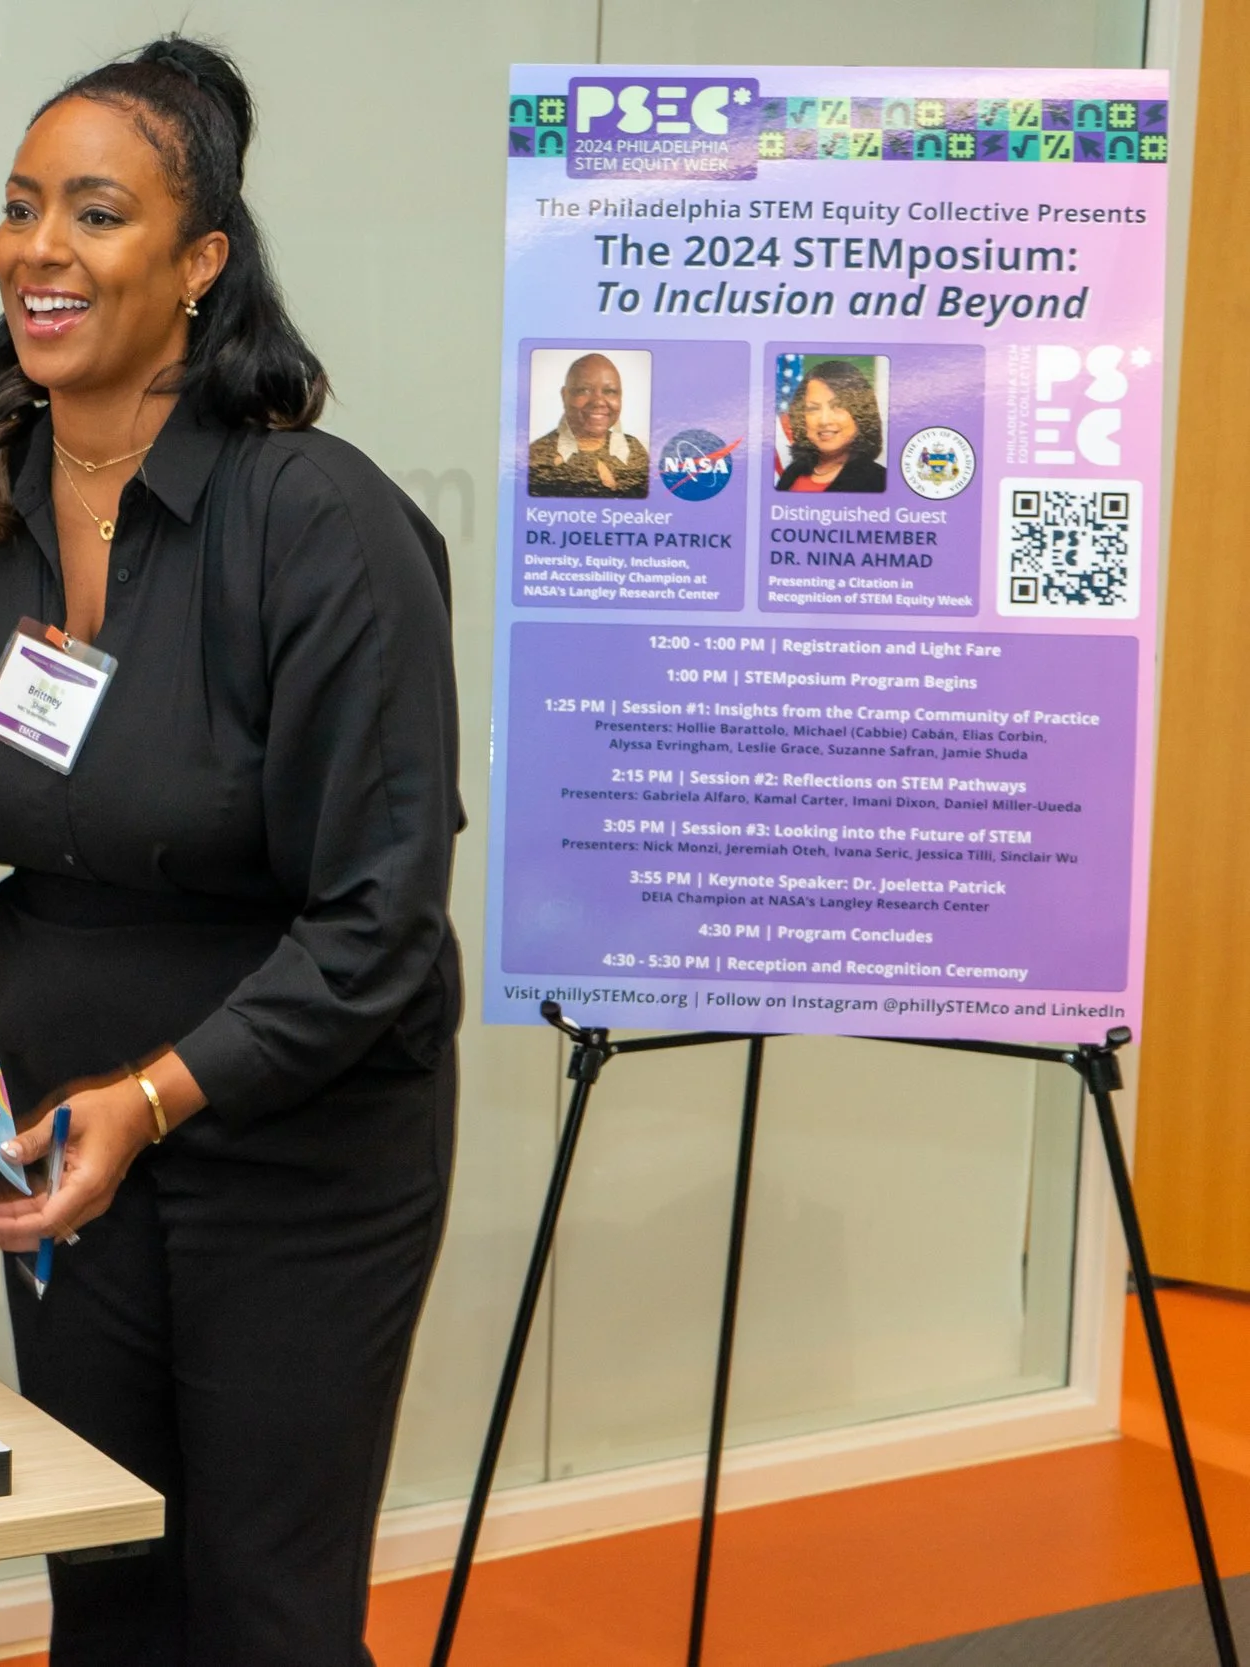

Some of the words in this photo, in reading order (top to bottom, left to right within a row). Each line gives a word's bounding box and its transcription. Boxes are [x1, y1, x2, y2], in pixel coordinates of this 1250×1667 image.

[574, 139, 612, 153] 2024
[617, 140, 728, 154] PHILADELPHIA
[575, 157, 617, 170] STEM
[621, 157, 680, 174] EQUITY
[683, 157, 728, 171] WEEK
[535, 198, 580, 216] The
[588, 198, 740, 222] Philadelphia
[749, 200, 812, 218] STEM
[822, 201, 900, 225] Equity
[908, 201, 1029, 221] Collective
[1038, 204, 1146, 223] Presents
[594, 233, 670, 266] The
[684, 236, 780, 267] 2024
[793, 237, 1076, 277] STEMposium:
[597, 281, 639, 312] To
[653, 282, 834, 314] Inclusion
[848, 284, 926, 316] and
[937, 286, 1089, 326] Beyond
[664, 456, 729, 474] NASA
[526, 507, 597, 526] Keynote
[601, 508, 673, 527] Speaker
[770, 505, 890, 525] Distinguished
[895, 507, 947, 524] Guest
[526, 530, 555, 544] DR.
[559, 531, 648, 548] JOELETTA
[654, 533, 731, 548] PATRICK
[770, 528, 937, 545] COUNCILMEMBER
[524, 554, 582, 568] Diversity,
[585, 555, 627, 569] Equity,
[630, 556, 689, 569] Inclusion,
[770, 550, 800, 565] DR.
[807, 551, 856, 566] NINA
[861, 553, 933, 568] AHMAD
[523, 570, 548, 580] and
[549, 570, 626, 584] Accessibility
[628, 572, 691, 585] Champion
[693, 574, 707, 584] at
[768, 575, 836, 590] Presenting
[837, 578, 846, 588] a
[848, 577, 898, 588] Citation
[901, 578, 913, 589] in
[523, 585, 566, 596] NASA's
[569, 586, 617, 600] Langley
[619, 587, 675, 598] Research
[677, 588, 720, 600] Center
[768, 591, 842, 605] Recognition
[844, 593, 858, 604] of
[860, 594, 892, 606] STEM
[895, 594, 935, 608] Equity
[937, 595, 973, 606] Week
[649, 635, 690, 649] 12:00
[704, 636, 736, 650] 1:00
[740, 637, 765, 651] PM
[782, 638, 881, 655] Registration
[885, 641, 916, 654] and
[920, 642, 961, 659] Light
[965, 643, 1001, 657] Fare
[667, 669, 699, 682] 1:00
[702, 669, 727, 682] PM
[744, 670, 846, 687] STEMposium
[850, 673, 919, 690] Program
[924, 675, 977, 692] Begins
[27, 684, 62, 710] Brittney
[545, 698, 576, 712] 1:25
[580, 699, 605, 712] PM
[622, 700, 682, 714] Session
[685, 702, 710, 715] #1:
[714, 703, 778, 720] Insights
[782, 704, 821, 718] from
[825, 705, 853, 719] the
[857, 706, 911, 723] Cramp
[914, 708, 1009, 726] Community
[1012, 710, 1030, 723] of
[1033, 710, 1100, 725] Practice
[18, 724, 41, 742] EMCEE
[595, 720, 672, 732] Presenters:
[676, 722, 716, 734] Hollie
[720, 723, 788, 736] Barattolo,
[793, 725, 847, 737] Michael
[850, 726, 907, 739] (Cabbie)
[911, 728, 957, 741] Cabán,
[962, 729, 994, 741] Elias
[997, 730, 1047, 743] Corbin,
[608, 738, 652, 752] Alyssa
[656, 739, 732, 754] Evringham,
[737, 742, 776, 753] Leslie
[780, 742, 823, 755] Grace,
[828, 744, 886, 756] Suzanne
[889, 745, 938, 758] Safran,
[941, 748, 982, 760] Jamie
[985, 748, 1028, 760] Shuda
[629, 870, 662, 884] 3:55
[666, 871, 691, 885] PM
[708, 873, 774, 889] Keynote
[778, 875, 848, 891] Speaker:
[852, 876, 876, 890] Dr.
[878, 878, 944, 893] Joeletta
[948, 880, 1006, 894] Patrick
[698, 923, 731, 937] 4:30
[735, 924, 760, 937] PM
[777, 925, 846, 943] Program
[850, 928, 933, 943] Concludes
[602, 953, 636, 967] 4:30
[648, 954, 681, 968] 5:30
[685, 955, 710, 968] PM
[727, 957, 807, 974] Reception
[811, 960, 842, 973] and
[846, 960, 941, 978] Recognition
[945, 964, 1028, 982] Ceremony
[504, 986, 540, 1001] Visit
[546, 987, 688, 1009] phillySTEMco.org
[706, 992, 761, 1006] Follow
[765, 996, 786, 1007] on
[792, 996, 878, 1013] Instagram
[883, 998, 1010, 1015] @phillySTEMco
[1014, 1002, 1046, 1016] and
[1051, 1002, 1126, 1018] LinkedIn
